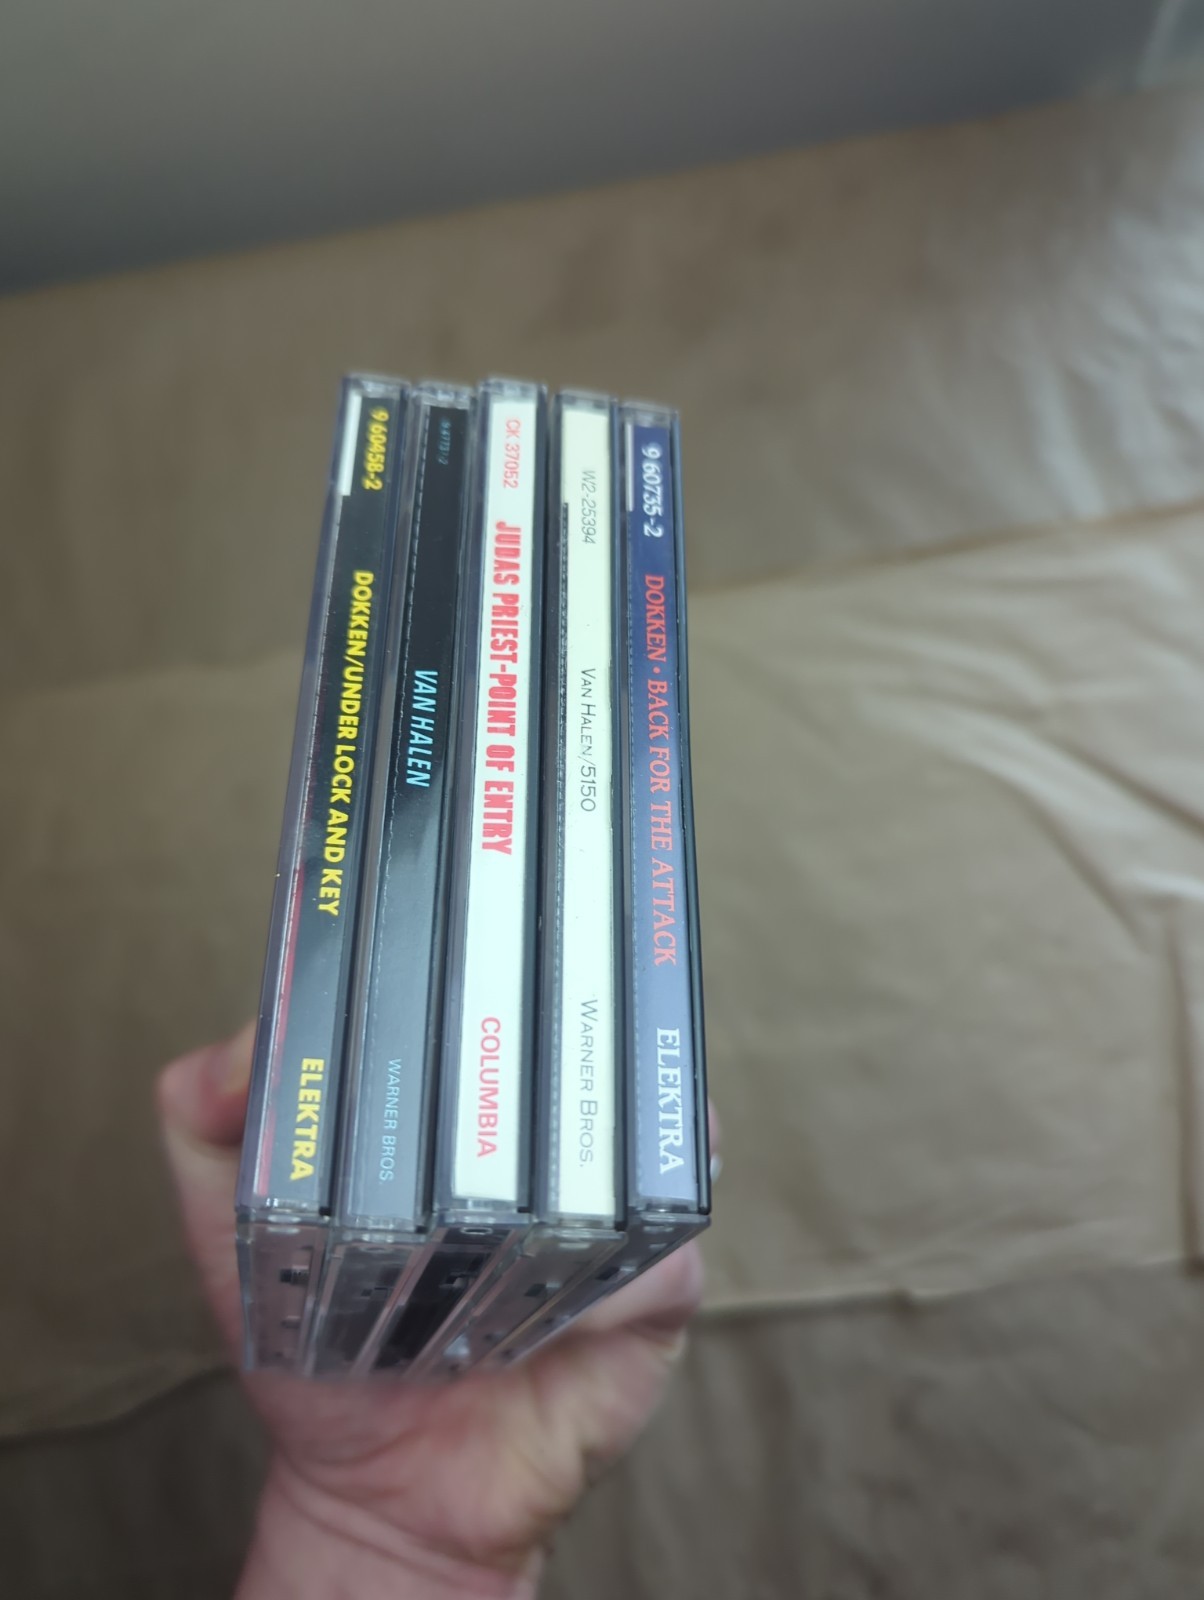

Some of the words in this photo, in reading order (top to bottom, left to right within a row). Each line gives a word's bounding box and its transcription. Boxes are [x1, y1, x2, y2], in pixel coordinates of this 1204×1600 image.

[370, 406, 390, 422] 9
[504, 419, 522, 440] CK
[361, 421, 389, 491] 60458-2
[503, 443, 521, 489] 37052
[642, 442, 663, 460] 9
[581, 470, 597, 545] W2-25394
[641, 461, 664, 538] 60735-2
[492, 521, 522, 586] JUDAS
[645, 574, 667, 663] DOKKEN
[336, 570, 375, 739] DOKKEN/UNDER
[486, 592, 520, 736] PRIEST-POINT
[413, 670, 438, 712] VAN
[647, 679, 669, 742] BACK
[331, 743, 357, 804] LOCK
[405, 715, 435, 788] HALEN
[484, 744, 517, 773] OF
[648, 746, 672, 793] FOR
[323, 808, 351, 863] AND
[481, 778, 515, 856] ENTRY
[650, 801, 673, 851] THE
[317, 867, 343, 916] KEY
[651, 857, 678, 967] ATTACK
[289, 1056, 326, 1182] ELEKTRA
[383, 1057, 403, 1130] WARNER
[476, 1016, 501, 1159] COLUMBIA
[656, 1027, 686, 1175] ELEKTRA
